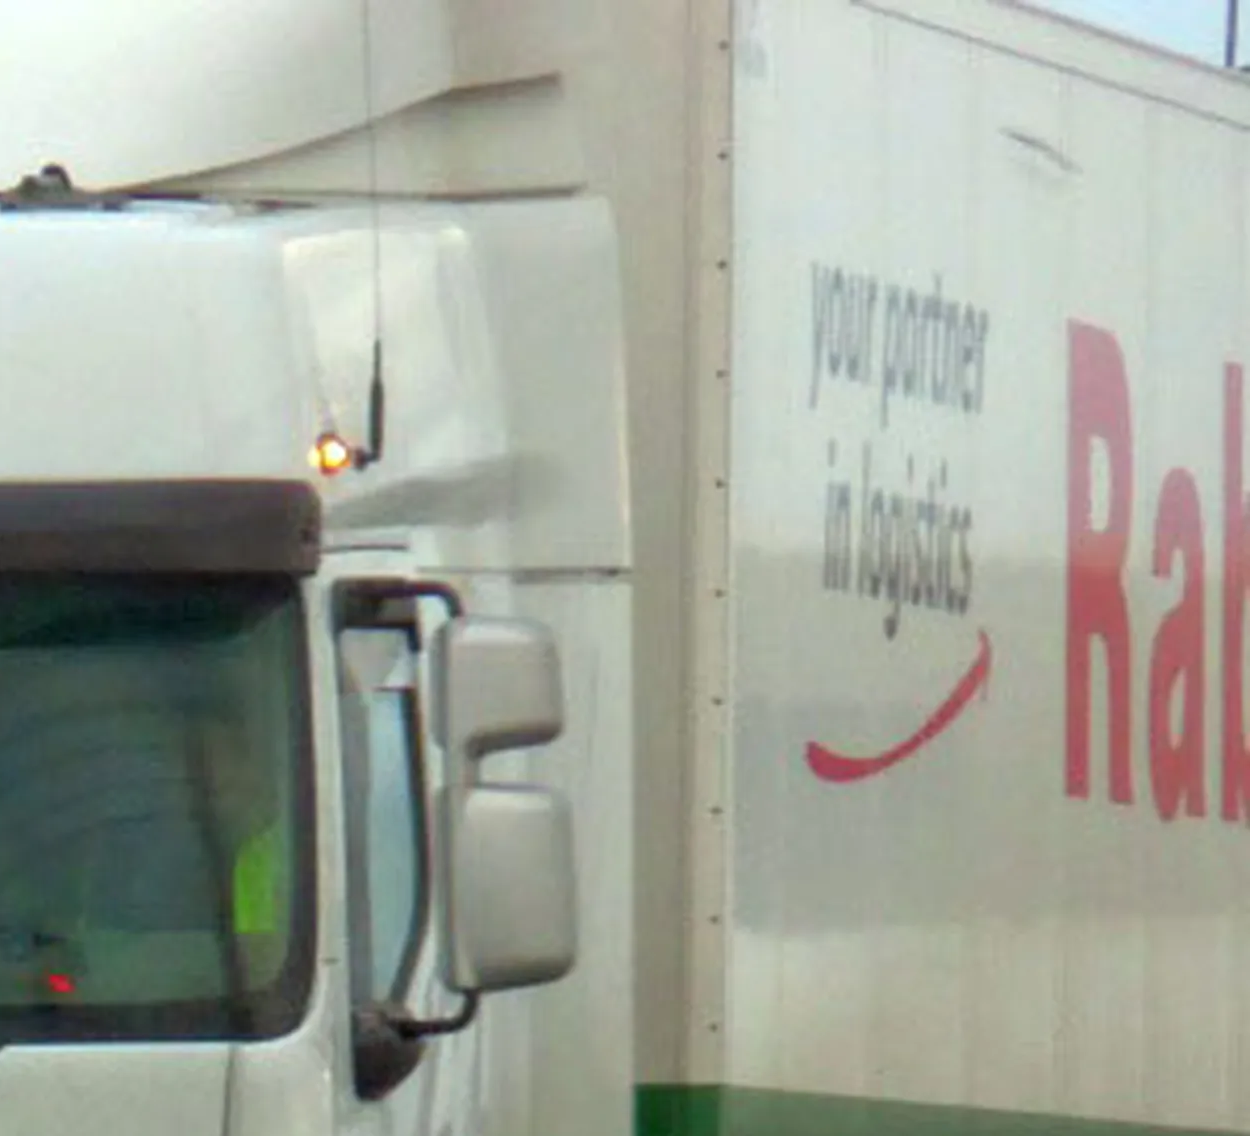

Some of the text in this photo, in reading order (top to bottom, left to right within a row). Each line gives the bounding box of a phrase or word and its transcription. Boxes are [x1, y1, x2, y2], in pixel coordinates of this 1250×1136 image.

[810, 262, 989, 431] your partner
[823, 438, 972, 640] in logistics
